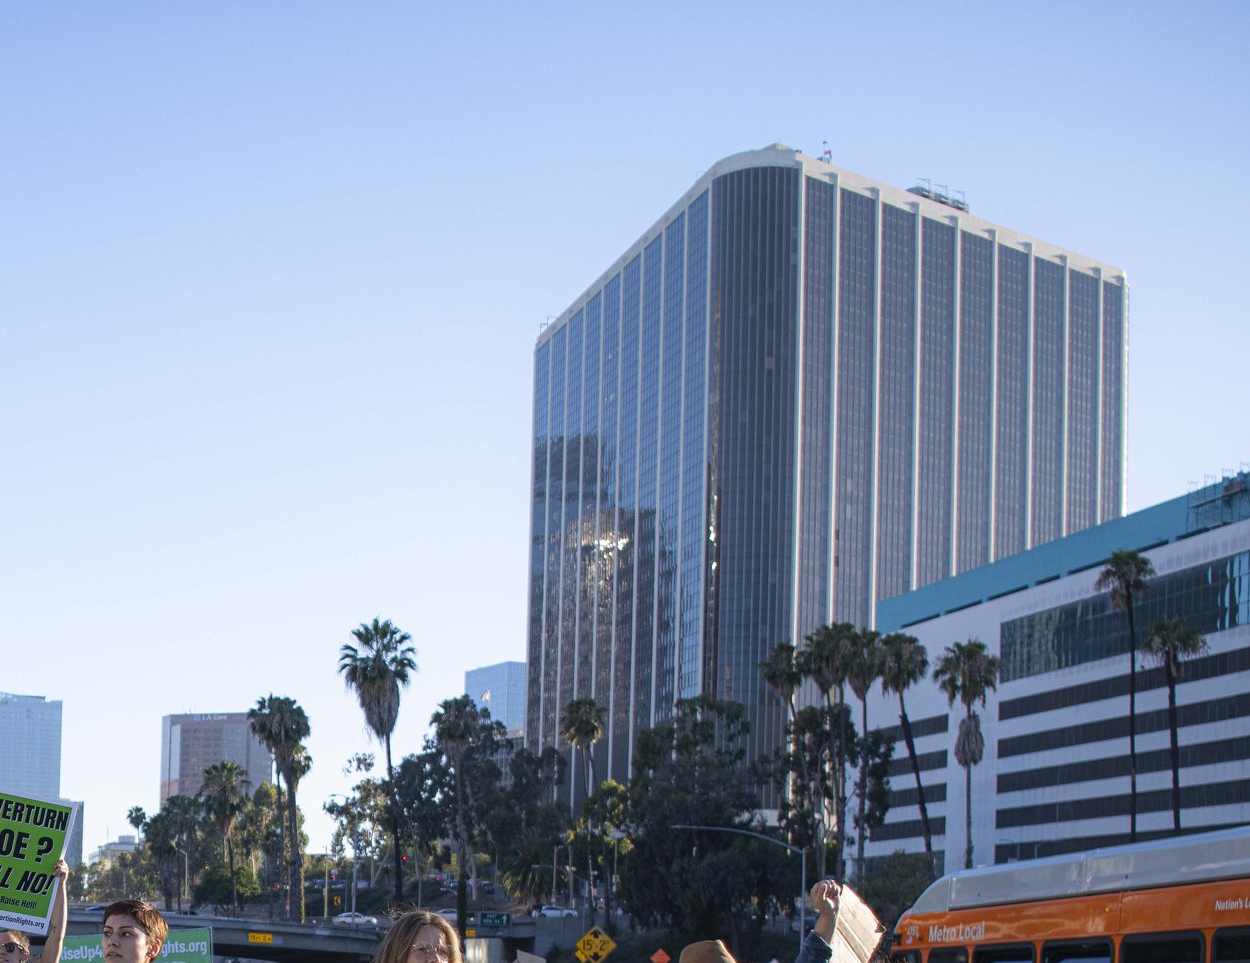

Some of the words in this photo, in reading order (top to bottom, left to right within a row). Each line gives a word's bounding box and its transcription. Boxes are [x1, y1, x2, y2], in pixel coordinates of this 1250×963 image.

[16, 870, 56, 896] NO!
[0, 896, 19, 906] Raise
[21, 900, 38, 909] Hell!
[929, 925, 957, 943] Metro
[959, 920, 986, 940] Local
